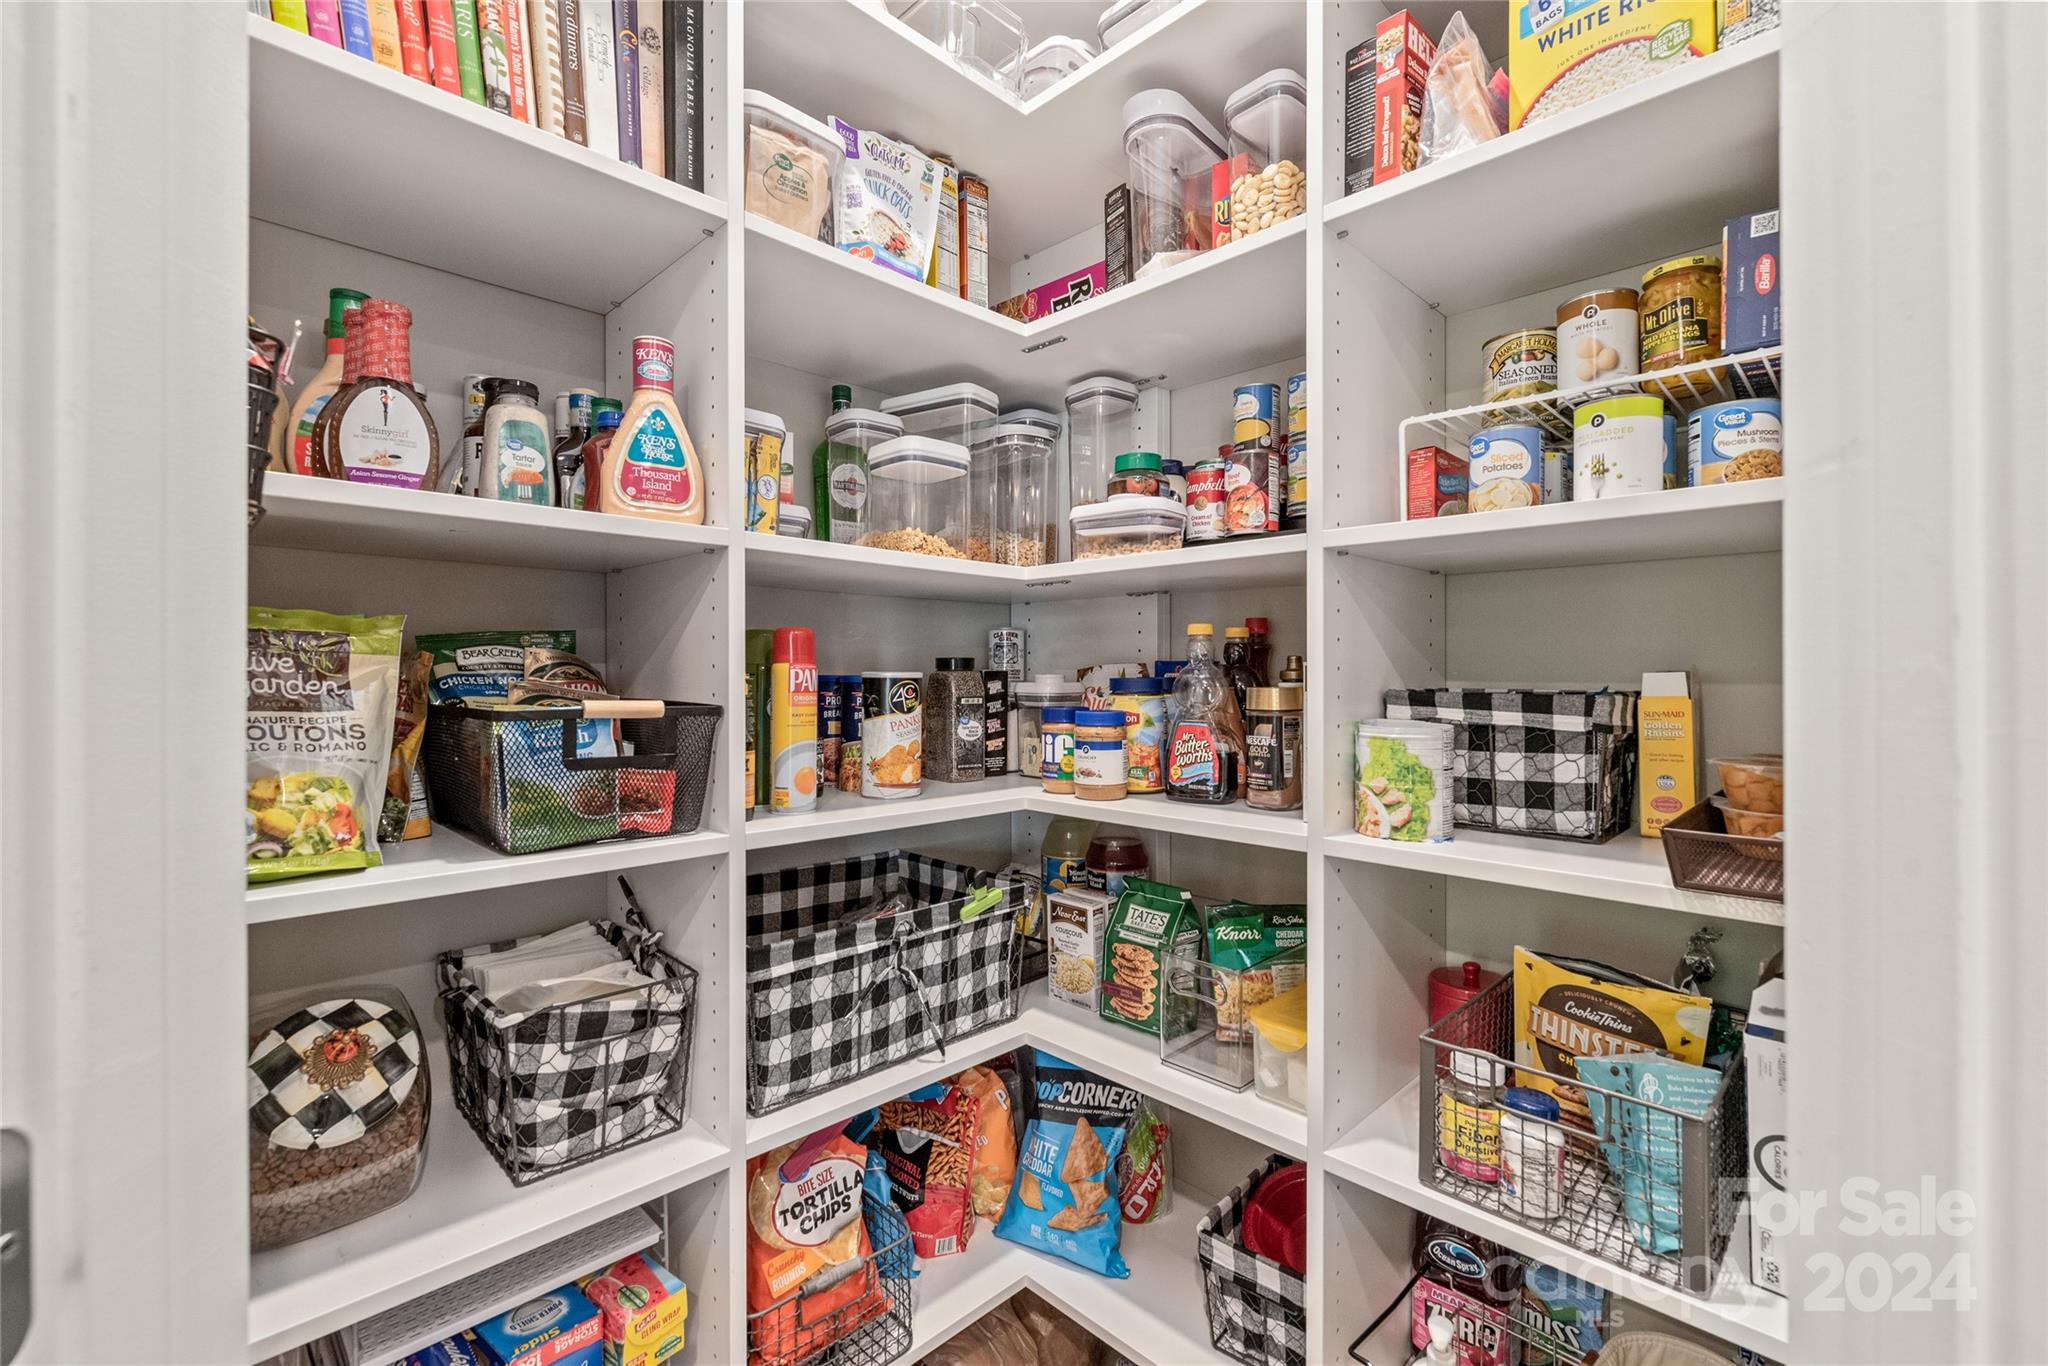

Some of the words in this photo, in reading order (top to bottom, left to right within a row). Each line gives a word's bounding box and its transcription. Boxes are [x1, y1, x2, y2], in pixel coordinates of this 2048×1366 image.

[1535, 5, 1563, 29] BAGS
[510, 18, 521, 50] Mama's
[1537, 4, 1611, 53] WHITE
[1651, 19, 1691, 47] RECYCLE
[566, 17, 580, 71] dinners
[686, 6, 695, 72] MAGNOLIA
[1556, 53, 1574, 70] JUST
[1577, 43, 1594, 57] ONE
[1598, 23, 1652, 45] INGREDIENT
[512, 51, 523, 77] Table
[687, 77, 695, 116] TABLE
[890, 191, 912, 220] OATS
[1759, 258, 1771, 289] Barilla
[1575, 318, 1608, 332] WHOLE
[1645, 315, 1659, 331] Mt.
[1659, 304, 1691, 325] Olive
[1661, 324, 1700, 339] BANANA
[636, 347, 674, 368] KEN'S
[1498, 377, 1517, 387] Italian
[1718, 411, 1746, 424] Great
[361, 424, 409, 439] Skinnygirl
[1599, 426, 1635, 436] ADDED
[1736, 428, 1780, 438] Mushroom
[637, 432, 677, 450] KEN'S
[1718, 436, 1749, 447] Pieces
[512, 453, 536, 463] Tartar
[1490, 452, 1524, 464] Sliced
[350, 468, 371, 478] Asian
[371, 469, 397, 479] Sesame
[397, 472, 421, 483] Ginger
[631, 465, 682, 483] Thousand
[1482, 462, 1524, 474] Potatoes
[642, 477, 673, 492] Island
[462, 648, 487, 660] BEAR
[487, 647, 523, 658] CREEK
[438, 676, 493, 690] CHICKEN
[299, 716, 347, 725] RECIPE
[1643, 720, 1682, 730] Golden
[1182, 732, 1195, 742] Mrs.
[1643, 728, 1686, 738] Raisins
[278, 742, 287, 752] &
[294, 741, 367, 753] ROMANO
[1175, 739, 1210, 755] Butter-
[1249, 746, 1269, 755] GOLD
[1176, 750, 1213, 767] worth's
[1052, 906, 1073, 921] Near
[1071, 911, 1087, 923] East
[1130, 907, 1168, 927] TATE'S
[1272, 915, 1287, 925] Rice
[1055, 926, 1084, 939] COUSCOUS
[1130, 919, 1144, 928] BAKE
[1145, 923, 1160, 932] SHOP
[1215, 925, 1262, 940] Knorr
[1275, 930, 1305, 939] CHEDDAR
[1603, 999, 1637, 1019] CRUNCHY
[1457, 1124, 1500, 1146] Fiber
[1029, 1136, 1060, 1165] WHITE
[1455, 1139, 1501, 1156] Digestive
[883, 1150, 922, 1179] ORIGINAL
[1022, 1153, 1053, 1178] CHEDDAR
[1774, 1145, 1783, 1180] CALORIES
[797, 1179, 817, 1197] BITE
[815, 1167, 835, 1186] SIZE
[1041, 1181, 1064, 1199] FLAVORED
[779, 1169, 864, 1228] TORTILLA
[799, 1194, 852, 1235] CHIPS
[767, 1249, 806, 1278] Crunchy
[1432, 1246, 1457, 1268] Ocean
[1455, 1258, 1480, 1274] Spray
[772, 1261, 807, 1293] ROUNDS
[539, 1300, 563, 1317] POWER
[509, 1313, 539, 1331] SHIELD
[635, 1311, 657, 1331] GLAD
[641, 1319, 662, 1339] CLING
[661, 1306, 682, 1325] WRAP
[511, 1325, 561, 1358] Slider
[554, 1323, 599, 1354] STORAGE
